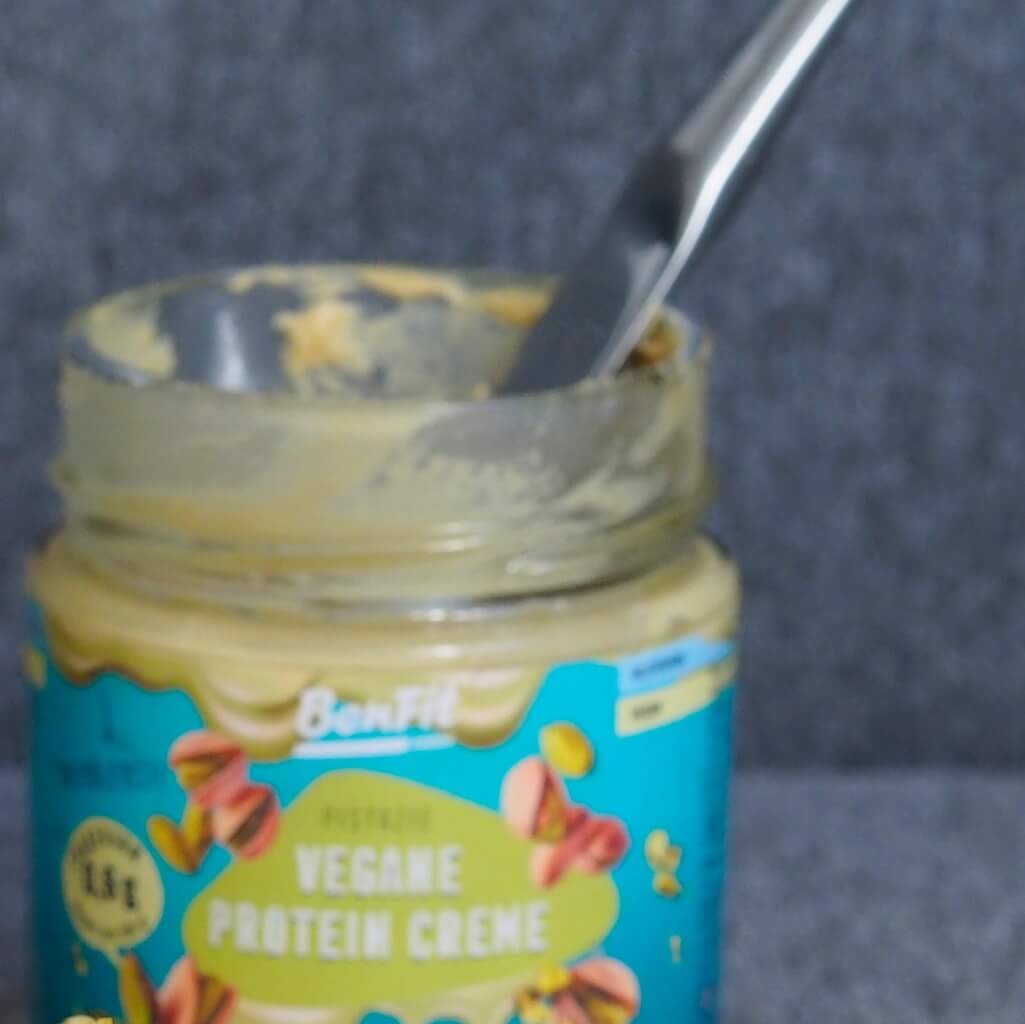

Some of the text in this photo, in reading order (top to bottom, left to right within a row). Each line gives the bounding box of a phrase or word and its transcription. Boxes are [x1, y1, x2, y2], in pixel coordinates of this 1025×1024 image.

[294, 844, 464, 897] VEGANE
[208, 899, 393, 961] PROTEIN
[407, 900, 551, 962] CREME
